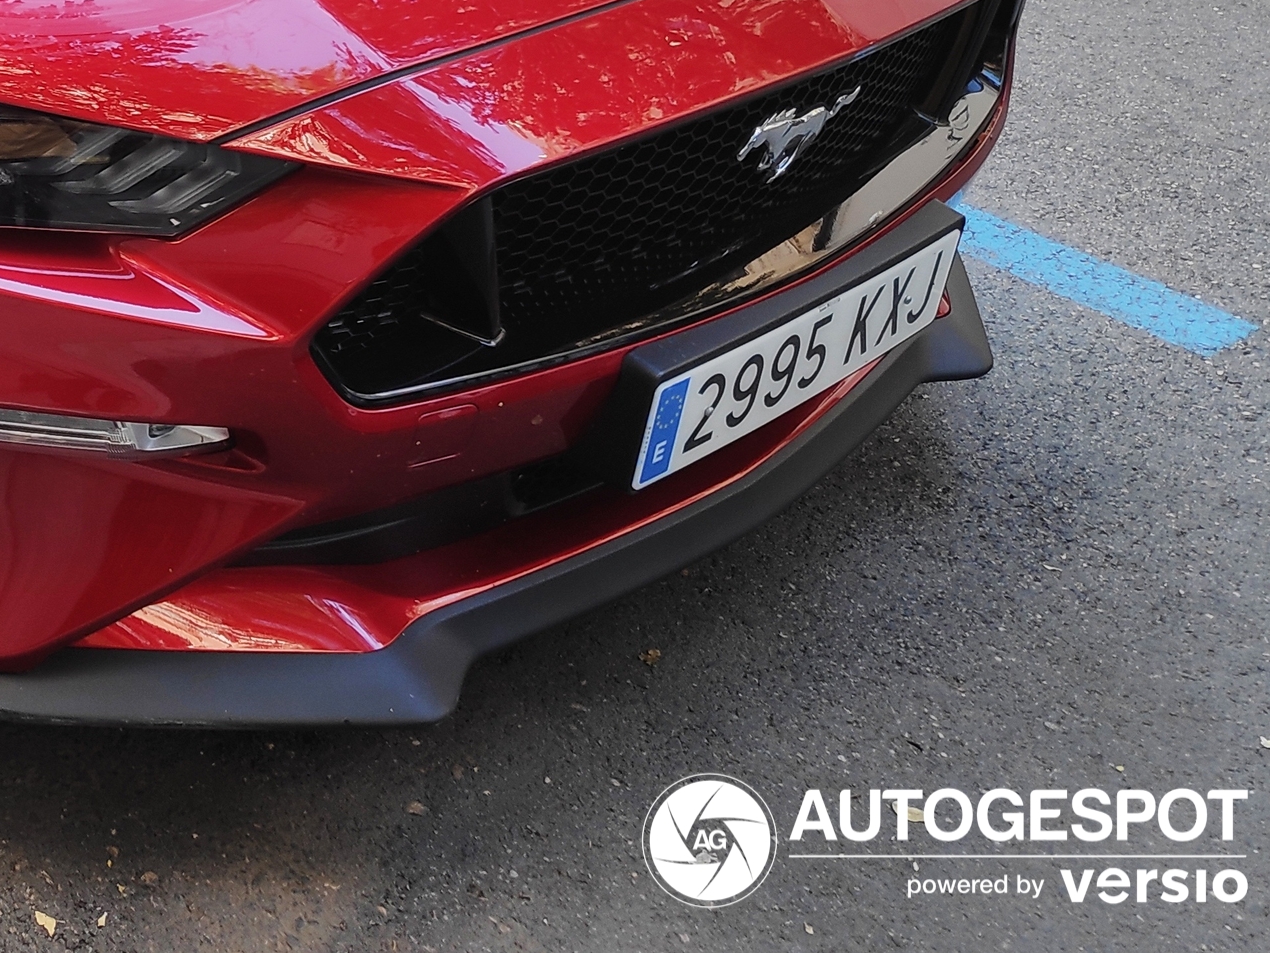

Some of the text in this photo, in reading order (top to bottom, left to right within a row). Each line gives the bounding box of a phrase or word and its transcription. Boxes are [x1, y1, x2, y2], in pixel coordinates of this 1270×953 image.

[651, 250, 944, 465] E 2995 KXJ
